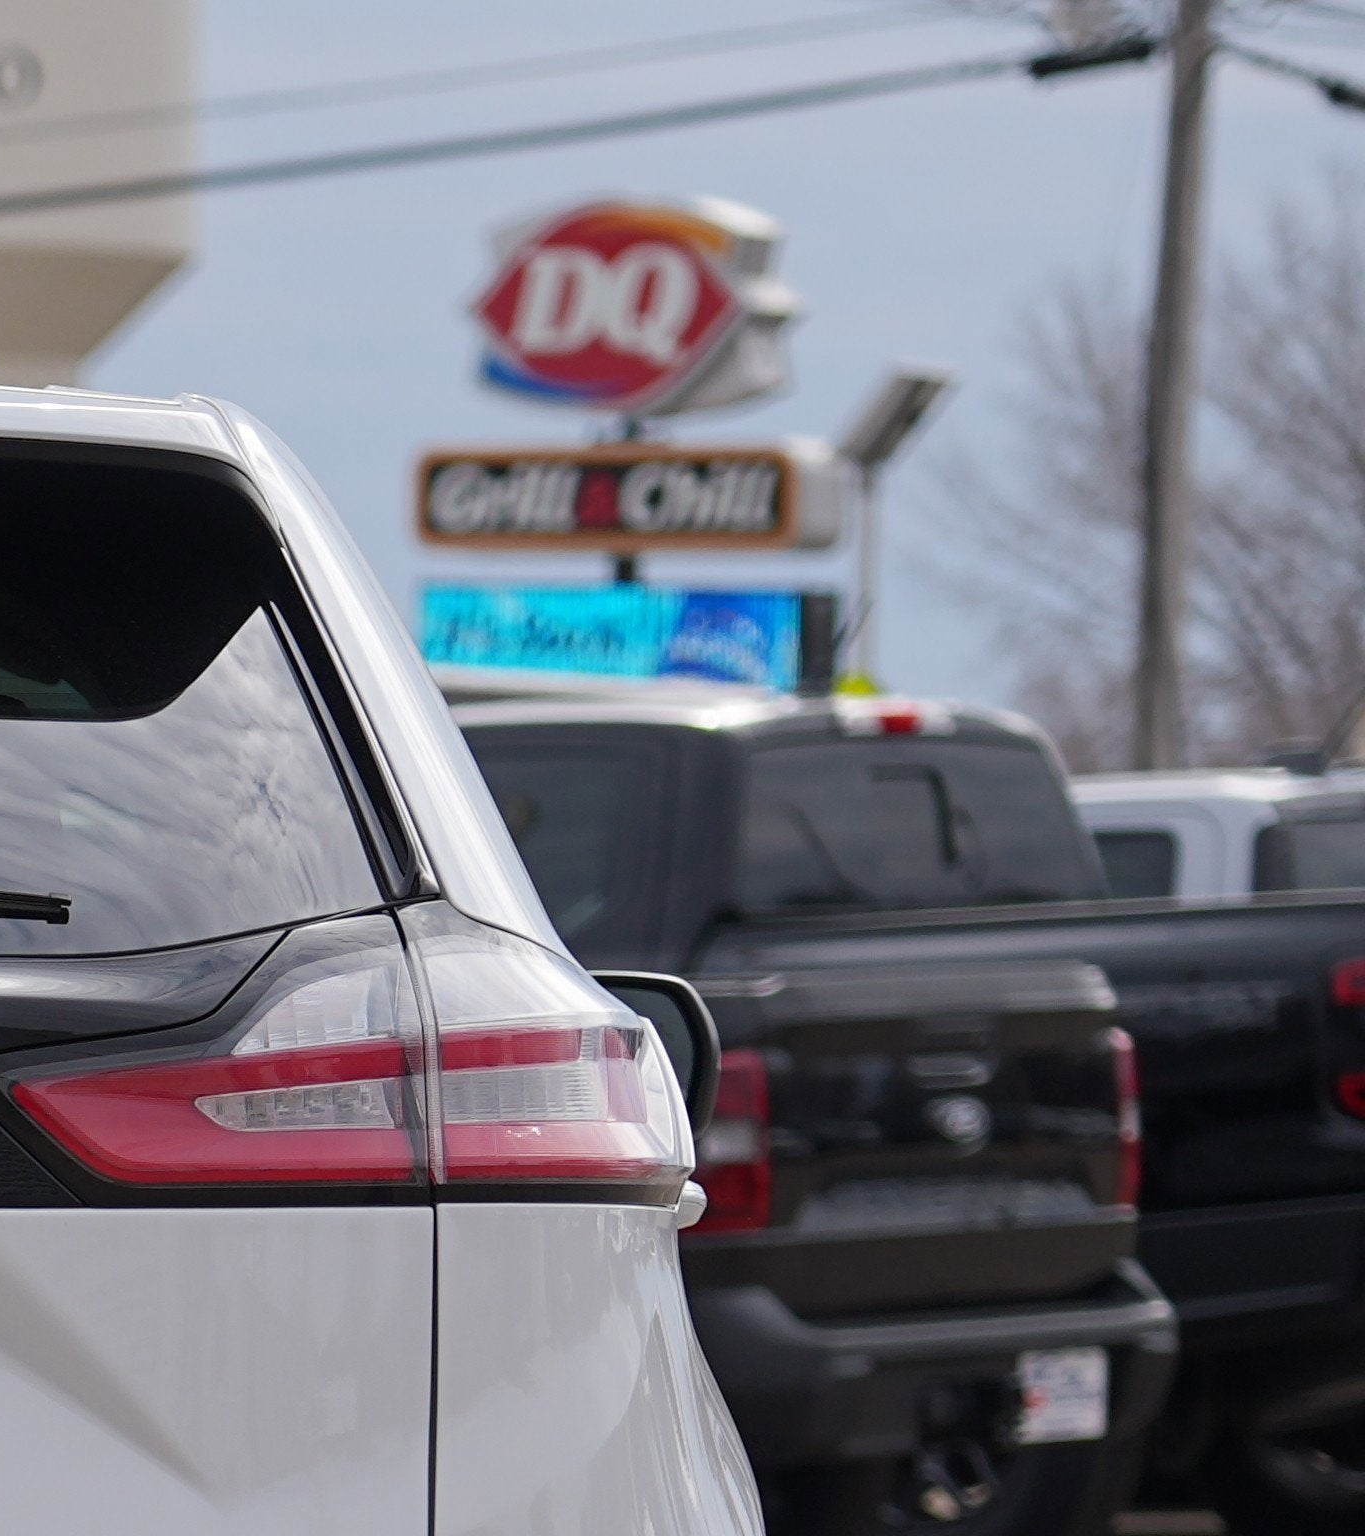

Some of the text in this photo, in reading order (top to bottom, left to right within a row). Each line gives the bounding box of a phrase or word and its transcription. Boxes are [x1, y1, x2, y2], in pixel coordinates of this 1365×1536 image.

[513, 240, 699, 370] DQ
[426, 462, 577, 536] Grill
[619, 462, 779, 536] Chill
